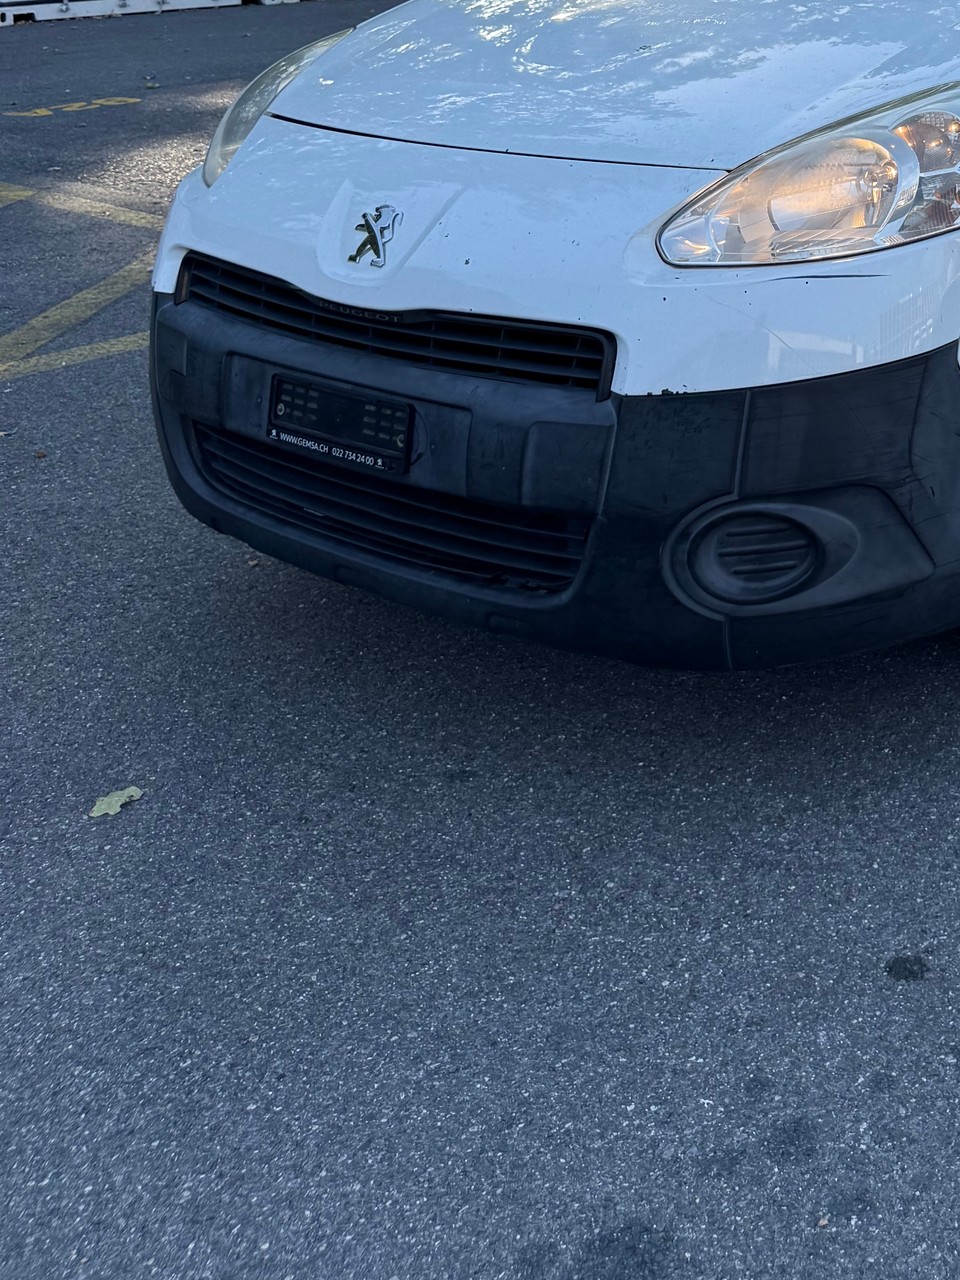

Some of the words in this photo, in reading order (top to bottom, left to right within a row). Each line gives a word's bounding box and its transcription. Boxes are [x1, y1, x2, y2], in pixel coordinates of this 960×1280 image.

[320, 301, 400, 322] PEUGEOT
[280, 432, 329, 453] WWW.GEMSA.CH
[332, 447, 344, 458] 022
[344, 450, 356, 461] 734
[356, 453, 365, 463] 24
[365, 456, 375, 466] 00
